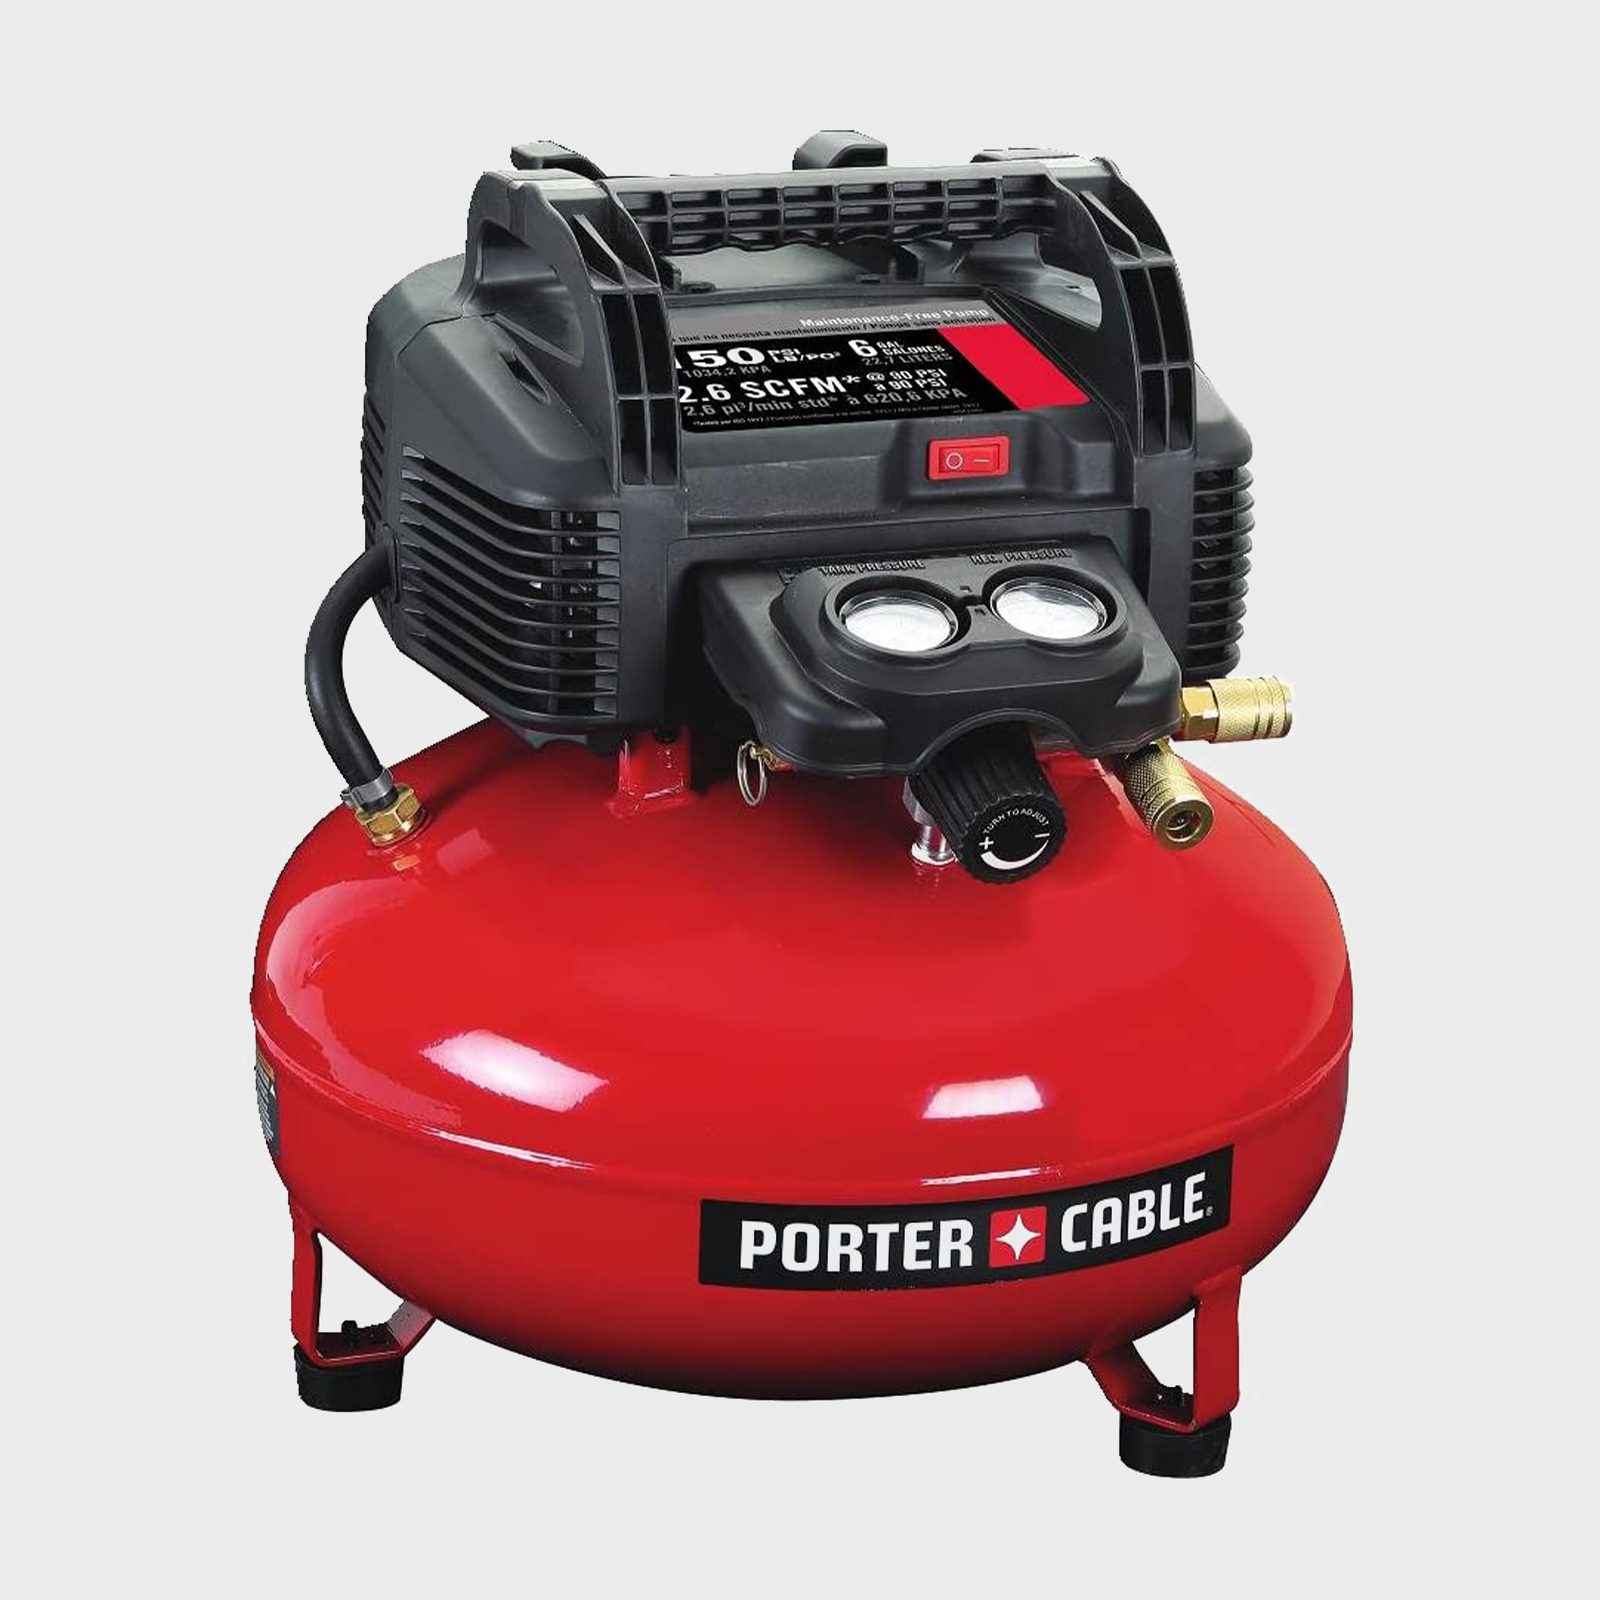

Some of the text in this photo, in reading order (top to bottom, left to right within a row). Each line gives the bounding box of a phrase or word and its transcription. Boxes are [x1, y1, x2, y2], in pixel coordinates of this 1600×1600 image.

[800, 308, 989, 327] Maintenance-Free Pump
[848, 339, 878, 357] 6
[740, 365, 771, 374] KPA
[889, 370, 913, 380] 90
[915, 368, 948, 378] PSI
[888, 380, 913, 390] 90
[915, 378, 947, 388] PSI
[678, 384, 731, 403] 2.6
[924, 388, 968, 399] KPA
[983, 808, 1050, 835] TURN TO ADJUST
[739, 1171, 1206, 1273] PORTER CABLE
